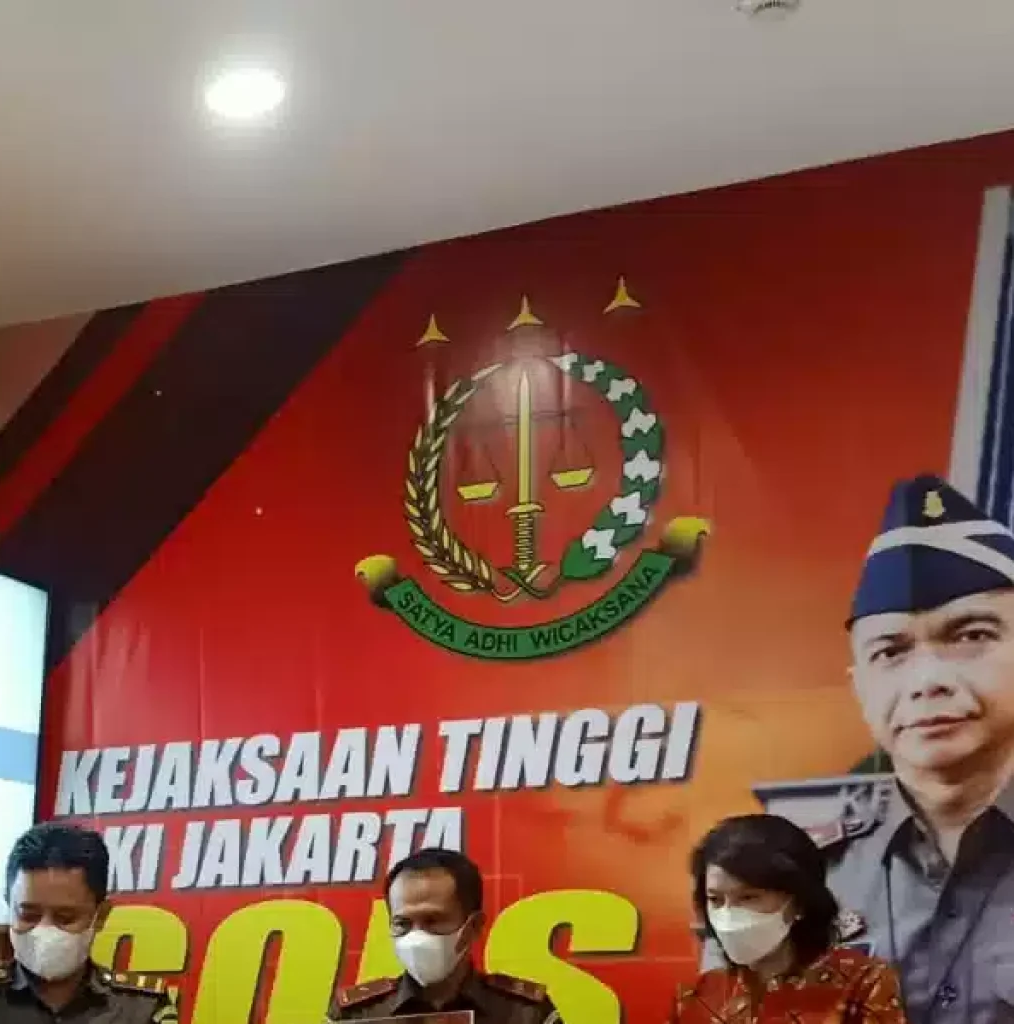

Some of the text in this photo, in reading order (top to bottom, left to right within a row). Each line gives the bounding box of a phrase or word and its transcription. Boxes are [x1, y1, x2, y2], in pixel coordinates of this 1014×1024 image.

[398, 564, 662, 654] SATYA ADHI WICAKSANA
[54, 702, 700, 816] KEJAKSAAN TINGGI
[106, 807, 463, 891] KI JAKARTA
